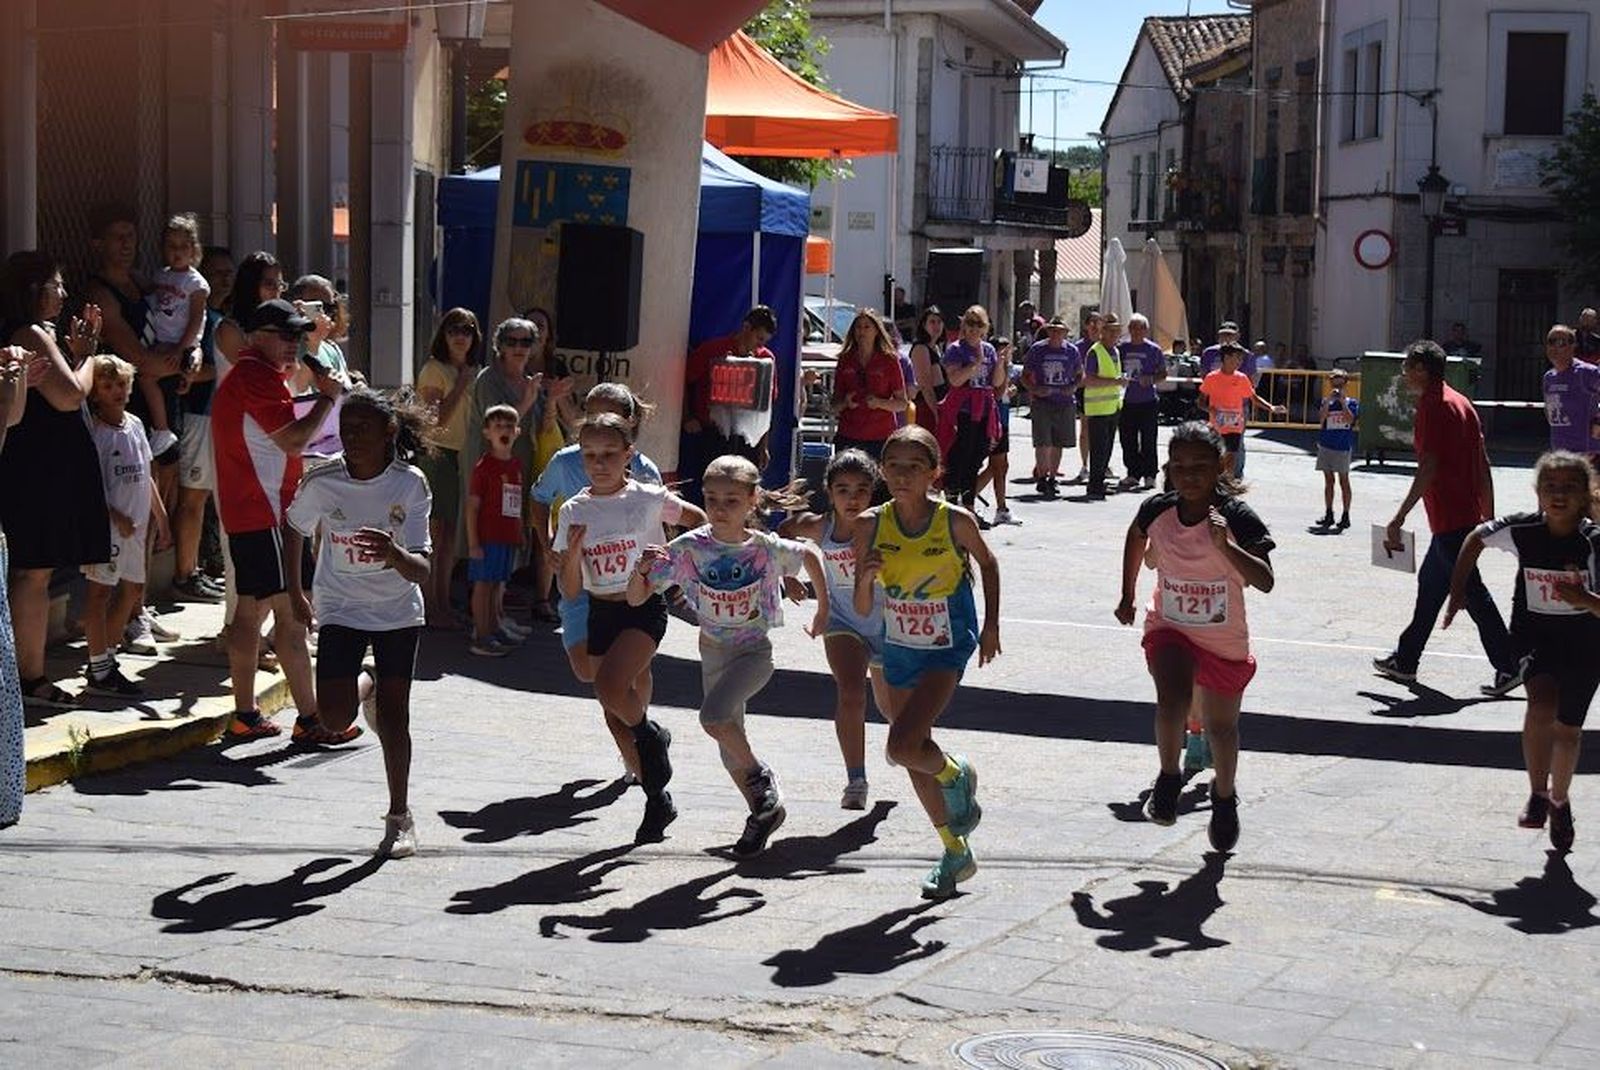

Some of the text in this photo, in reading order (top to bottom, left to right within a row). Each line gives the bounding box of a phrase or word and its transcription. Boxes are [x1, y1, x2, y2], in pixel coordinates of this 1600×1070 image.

[582, 539, 637, 557] edunia
[592, 554, 628, 577] 149
[711, 601, 750, 617] 113
[1174, 595, 1212, 615] 121
[896, 615, 935, 636] 126
